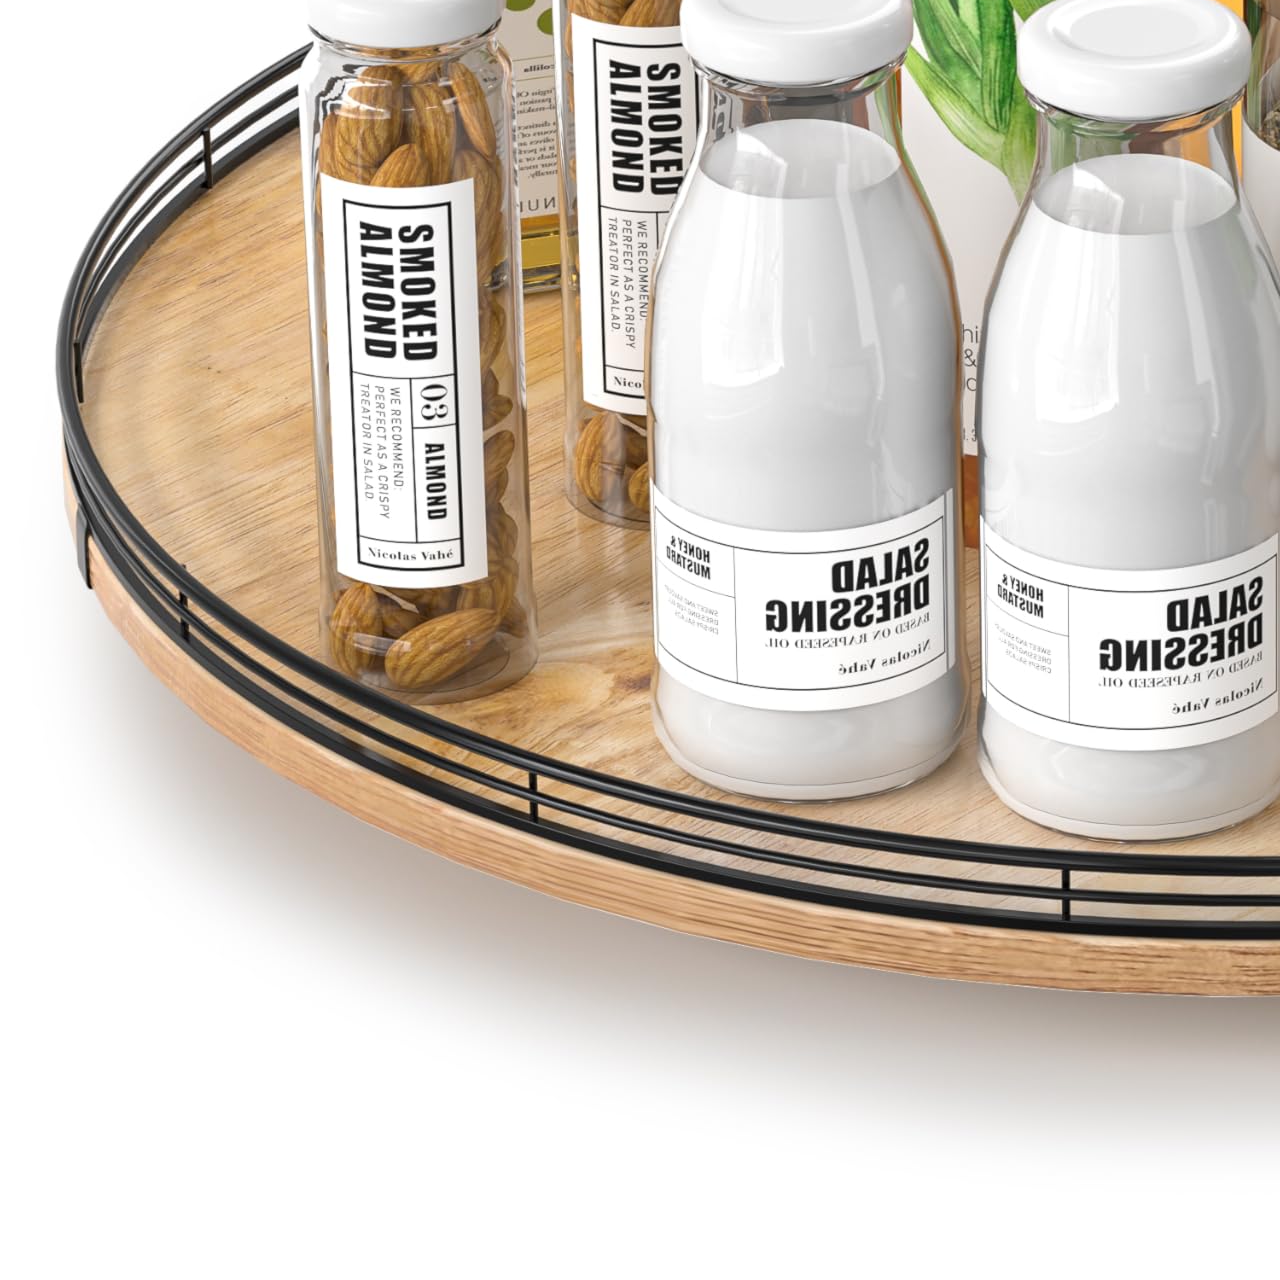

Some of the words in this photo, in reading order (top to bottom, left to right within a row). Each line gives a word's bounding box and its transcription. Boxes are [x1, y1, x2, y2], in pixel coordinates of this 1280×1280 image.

[608, 59, 644, 193] ALMOND
[646, 62, 683, 195] SMOKED
[607, 217, 620, 270] TREATOR
[622, 219, 634, 272] PERFECT
[637, 220, 648, 238] WE
[359, 220, 397, 360] ALMOND
[398, 223, 439, 361] SMOKED
[610, 274, 620, 287] IN
[623, 275, 634, 292] AS
[624, 294, 634, 302] A
[624, 306, 636, 349] CRISPY
[390, 387, 401, 405] WE
[420, 383, 450, 421] 03
[613, 375, 642, 389] Nico
[359, 383, 371, 438] TREATOR
[374, 385, 387, 440] PERFECT
[362, 442, 372, 455] IN
[377, 443, 388, 460] AS
[378, 463, 388, 471] A
[378, 475, 391, 519] CRISPY
[425, 442, 448, 521] ALMOND
[367, 546, 417, 561] Nicolas
[421, 548, 454, 561] Vahé
